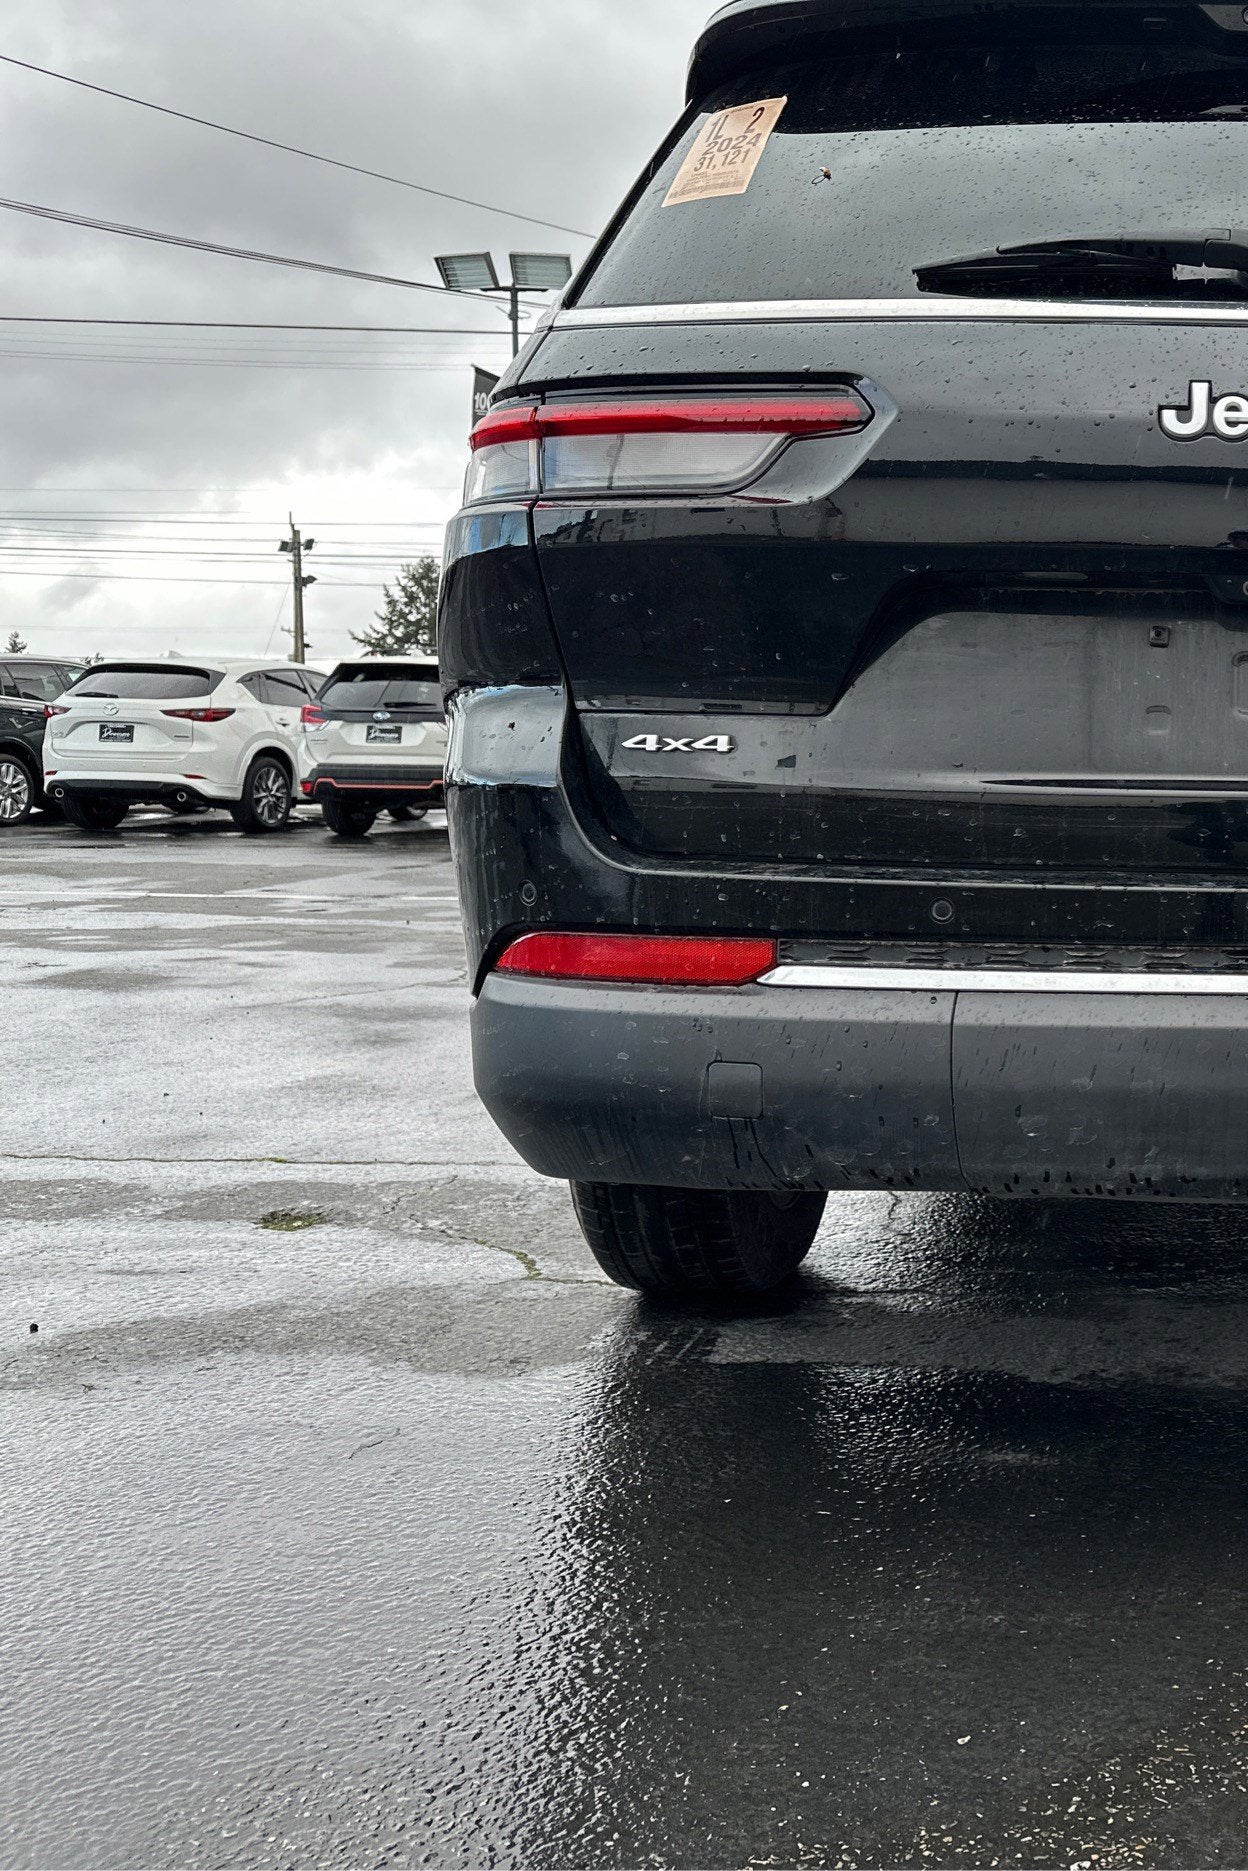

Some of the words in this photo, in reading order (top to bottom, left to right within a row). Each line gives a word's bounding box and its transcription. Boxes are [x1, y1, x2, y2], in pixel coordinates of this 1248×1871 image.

[744, 106, 766, 133] 2
[701, 132, 762, 156] 2024
[693, 150, 750, 173] 31,121
[621, 734, 735, 752] 4x4
